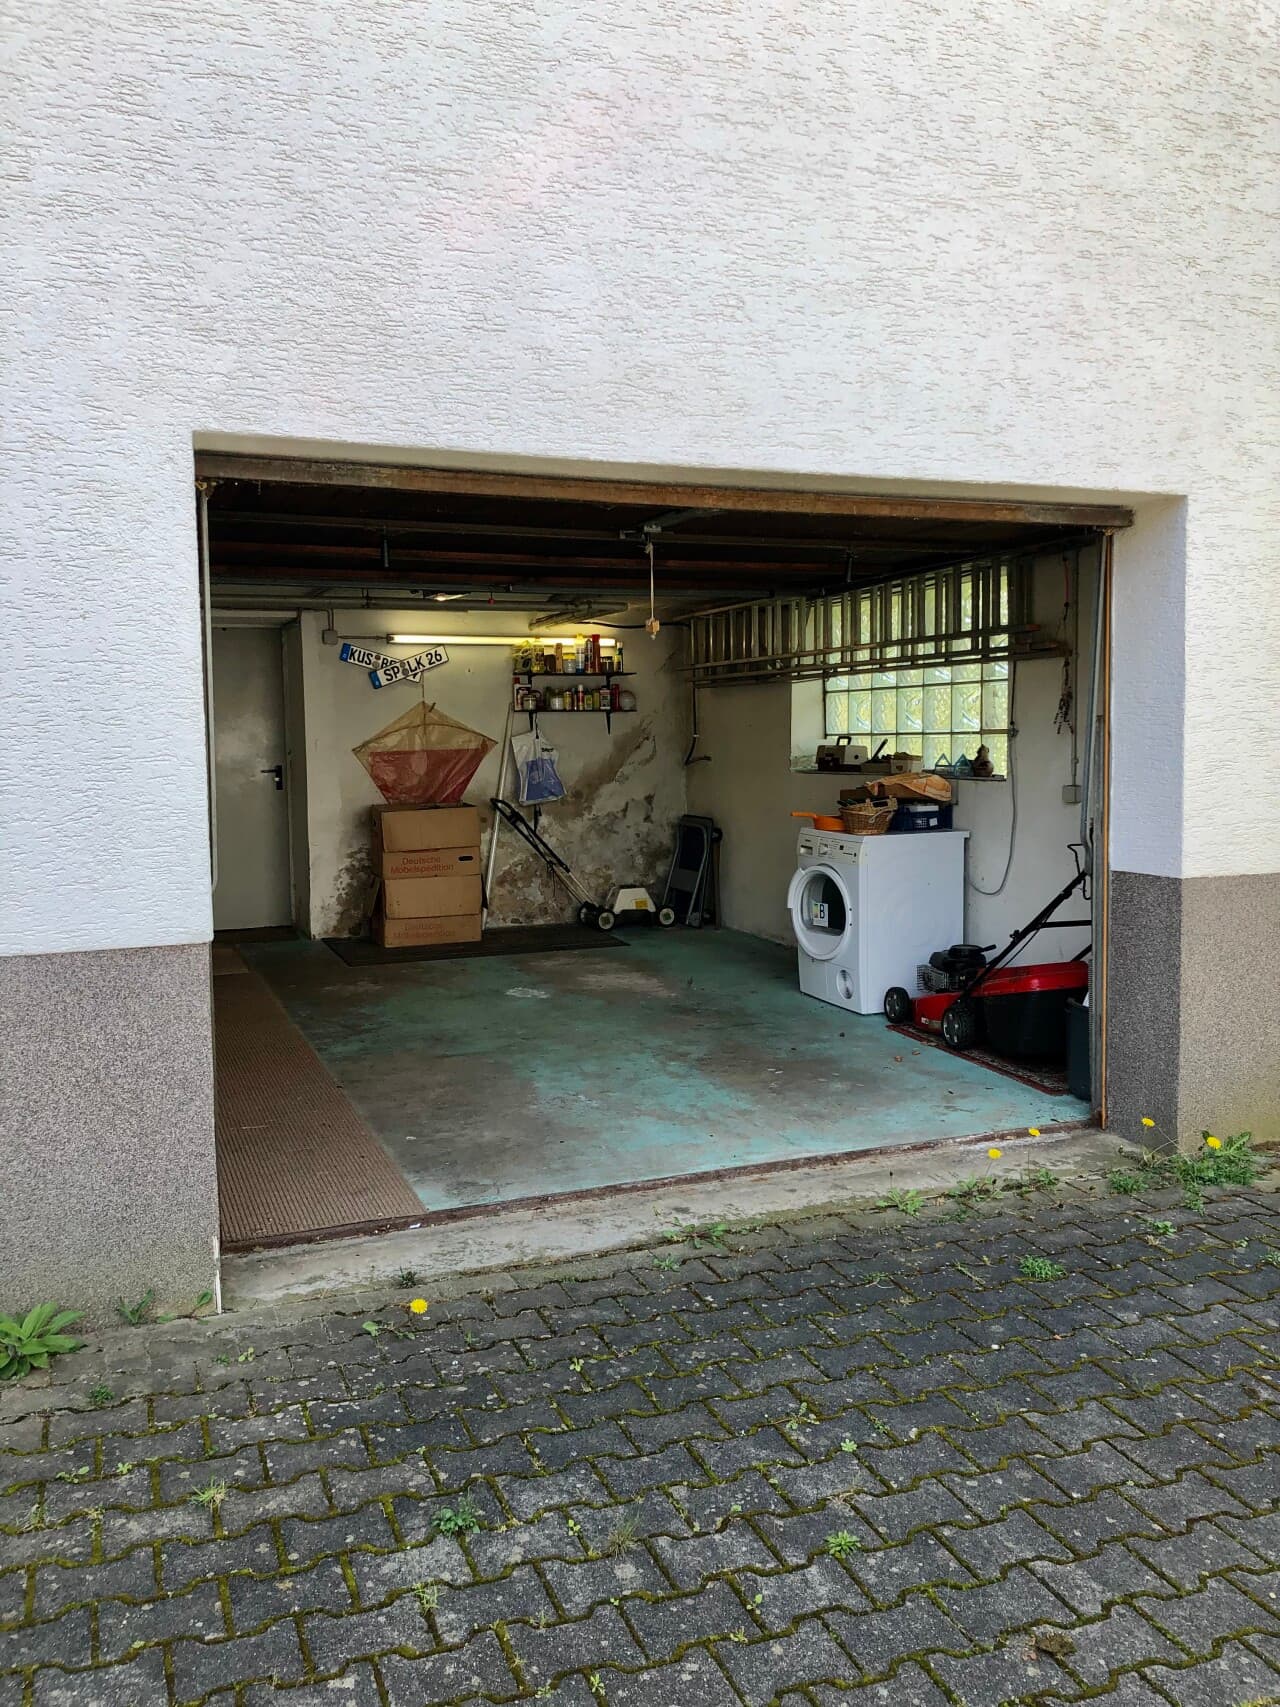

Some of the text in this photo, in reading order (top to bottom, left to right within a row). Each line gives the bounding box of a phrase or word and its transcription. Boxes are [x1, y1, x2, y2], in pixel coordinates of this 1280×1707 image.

[349, 647, 374, 665] KUS
[384, 666, 400, 681] SP
[406, 655, 426, 672] LK
[426, 650, 442, 665] 26
